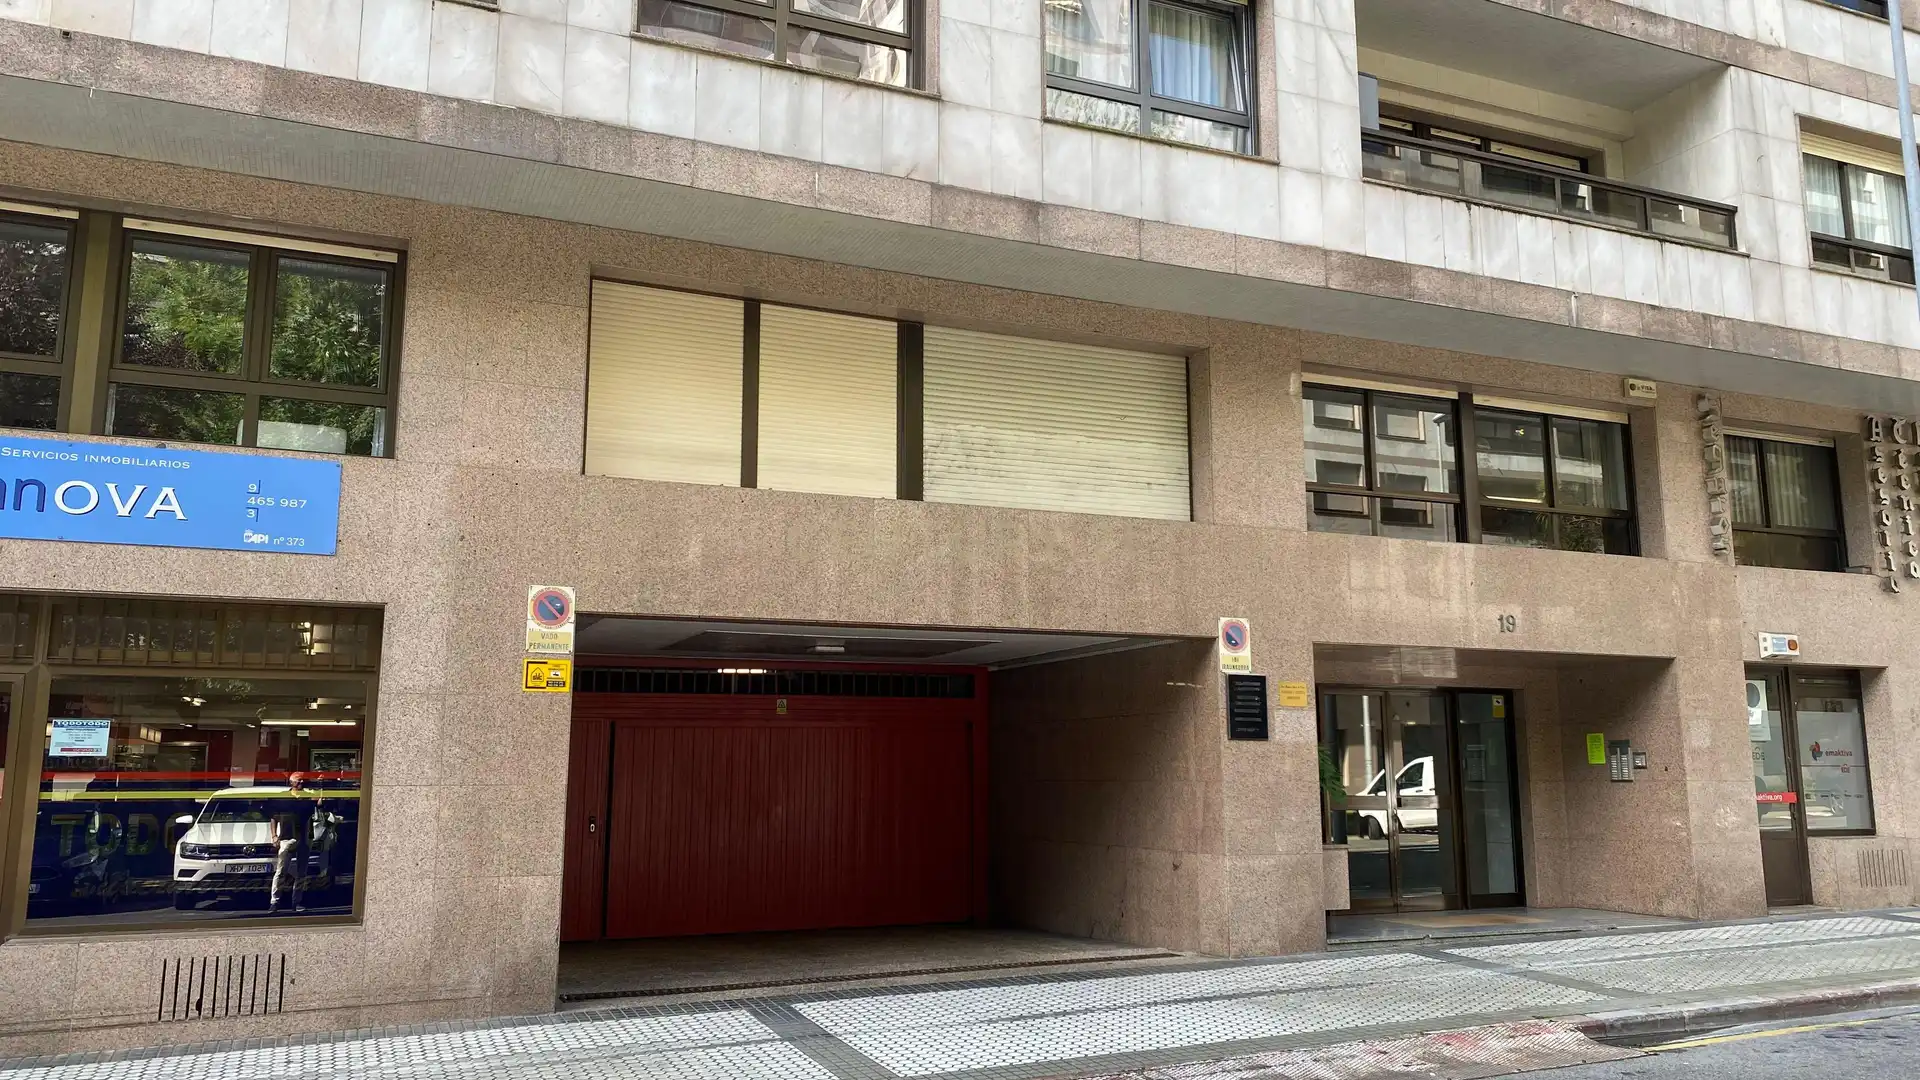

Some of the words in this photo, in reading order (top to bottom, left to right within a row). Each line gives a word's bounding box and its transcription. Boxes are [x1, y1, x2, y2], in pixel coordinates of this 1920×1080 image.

[1, 446, 79, 462] SERVICIOS
[84, 454, 191, 469] INMOBILIARIOS
[248, 483, 257, 493] 9
[0, 477, 188, 521] nOVA
[247, 496, 275, 507] 465
[279, 498, 308, 509] 987
[246, 508, 256, 518] 3
[286, 537, 305, 547] 373
[1497, 614, 1516, 633] 19
[541, 632, 558, 640] VADO
[528, 642, 569, 650] PERMANENTE
